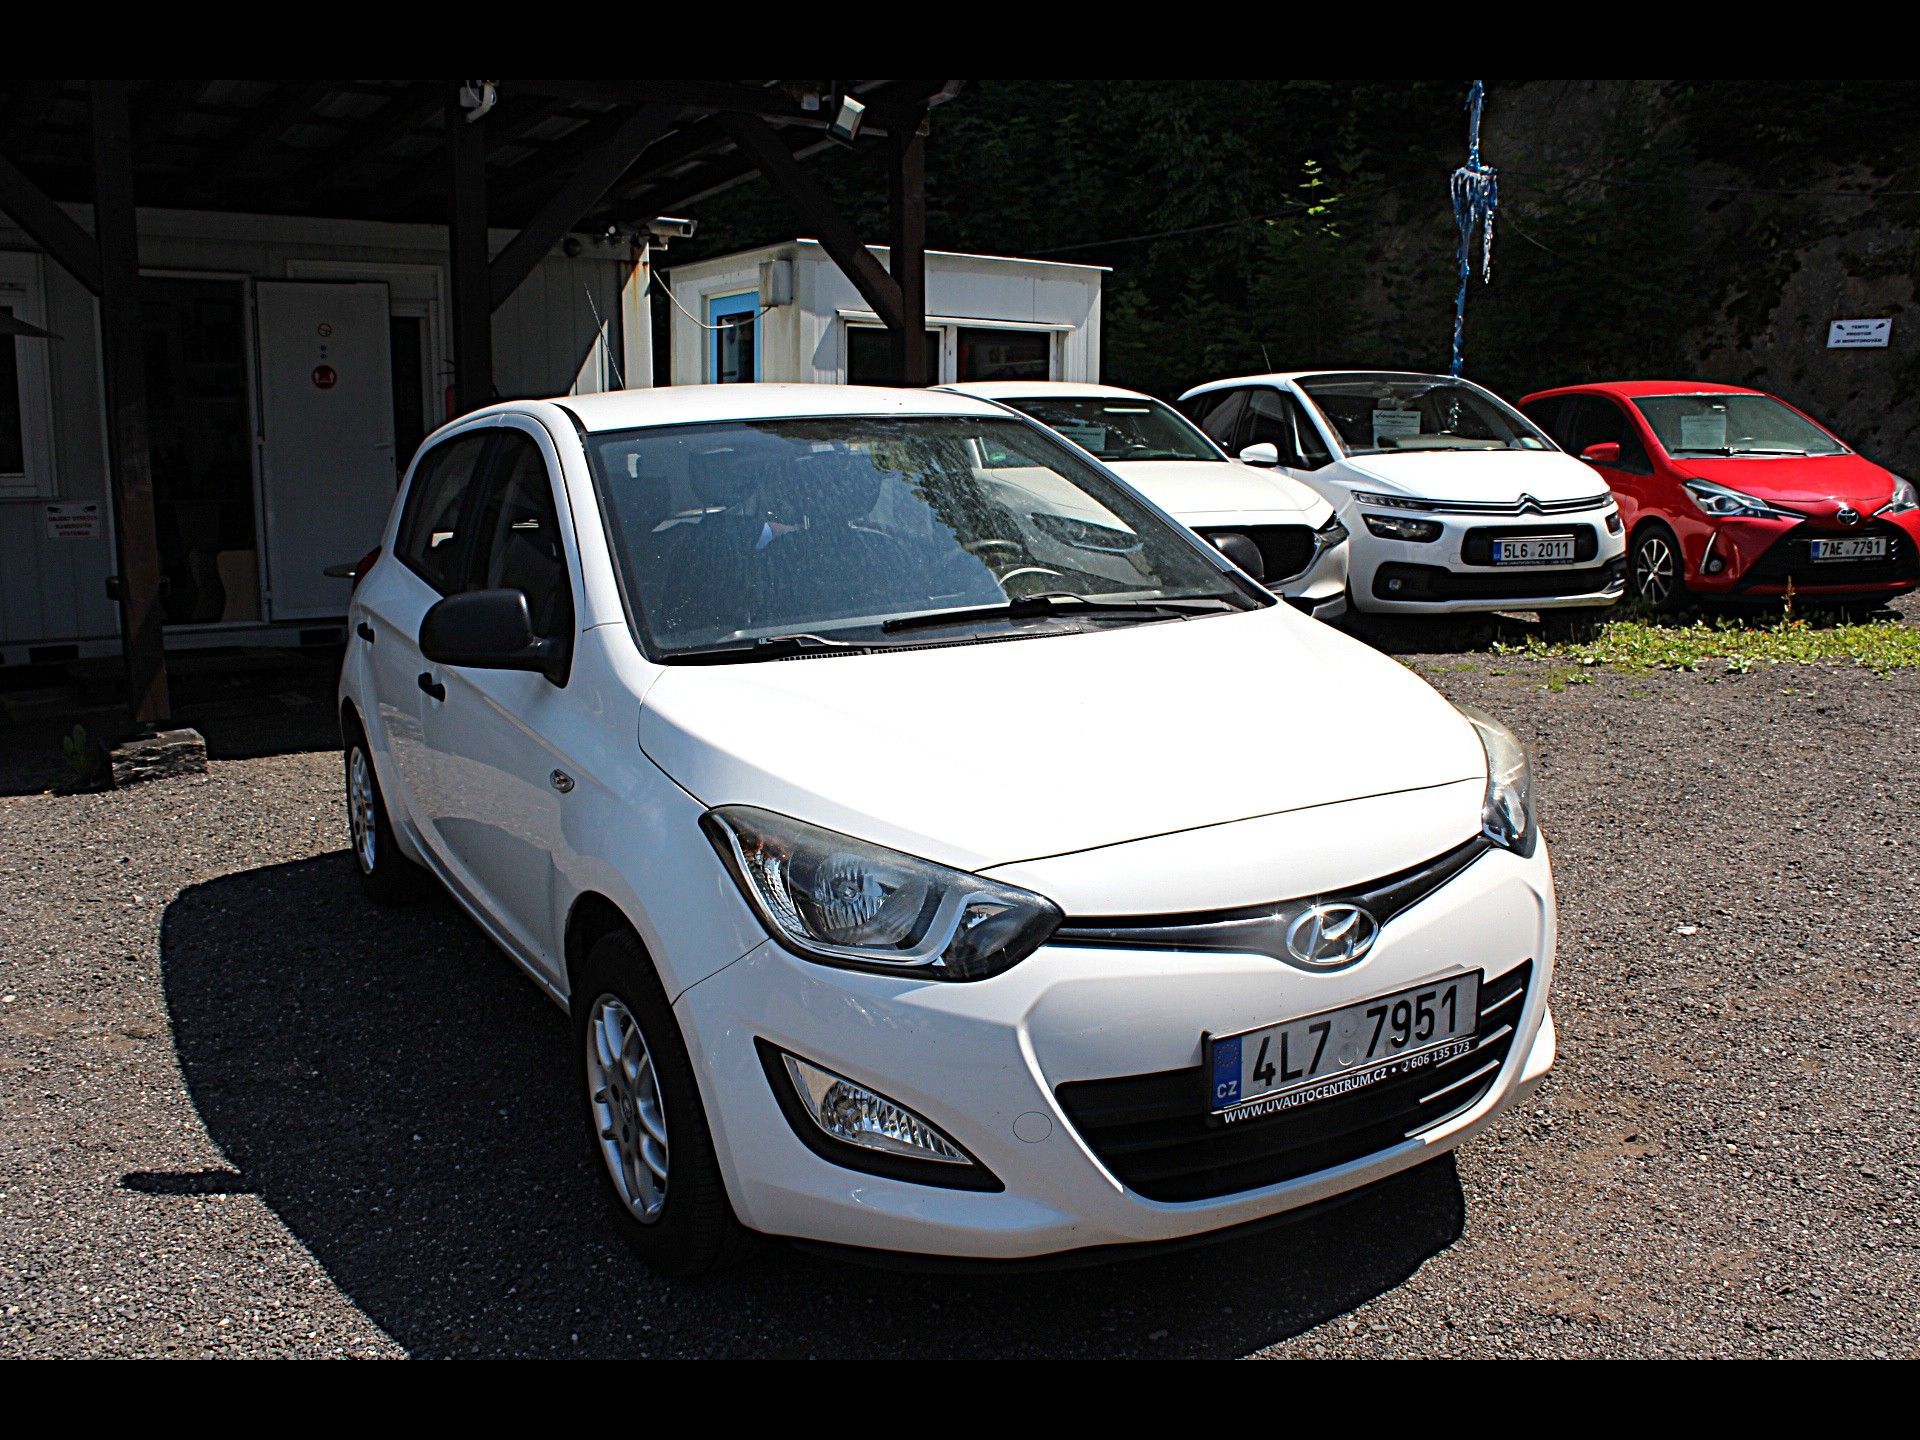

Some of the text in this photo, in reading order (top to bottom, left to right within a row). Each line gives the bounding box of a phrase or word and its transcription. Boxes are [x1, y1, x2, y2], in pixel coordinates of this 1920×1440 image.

[1504, 542, 1569, 559] 5L6 2011
[1822, 540, 1880, 556] 7AE 7791
[1252, 984, 1458, 1087] 4L7 7951
[1216, 1080, 1237, 1098] CZ
[1224, 1041, 1470, 1123] WWW.UVAUTOCENTRUM.CZ 606 135 173
